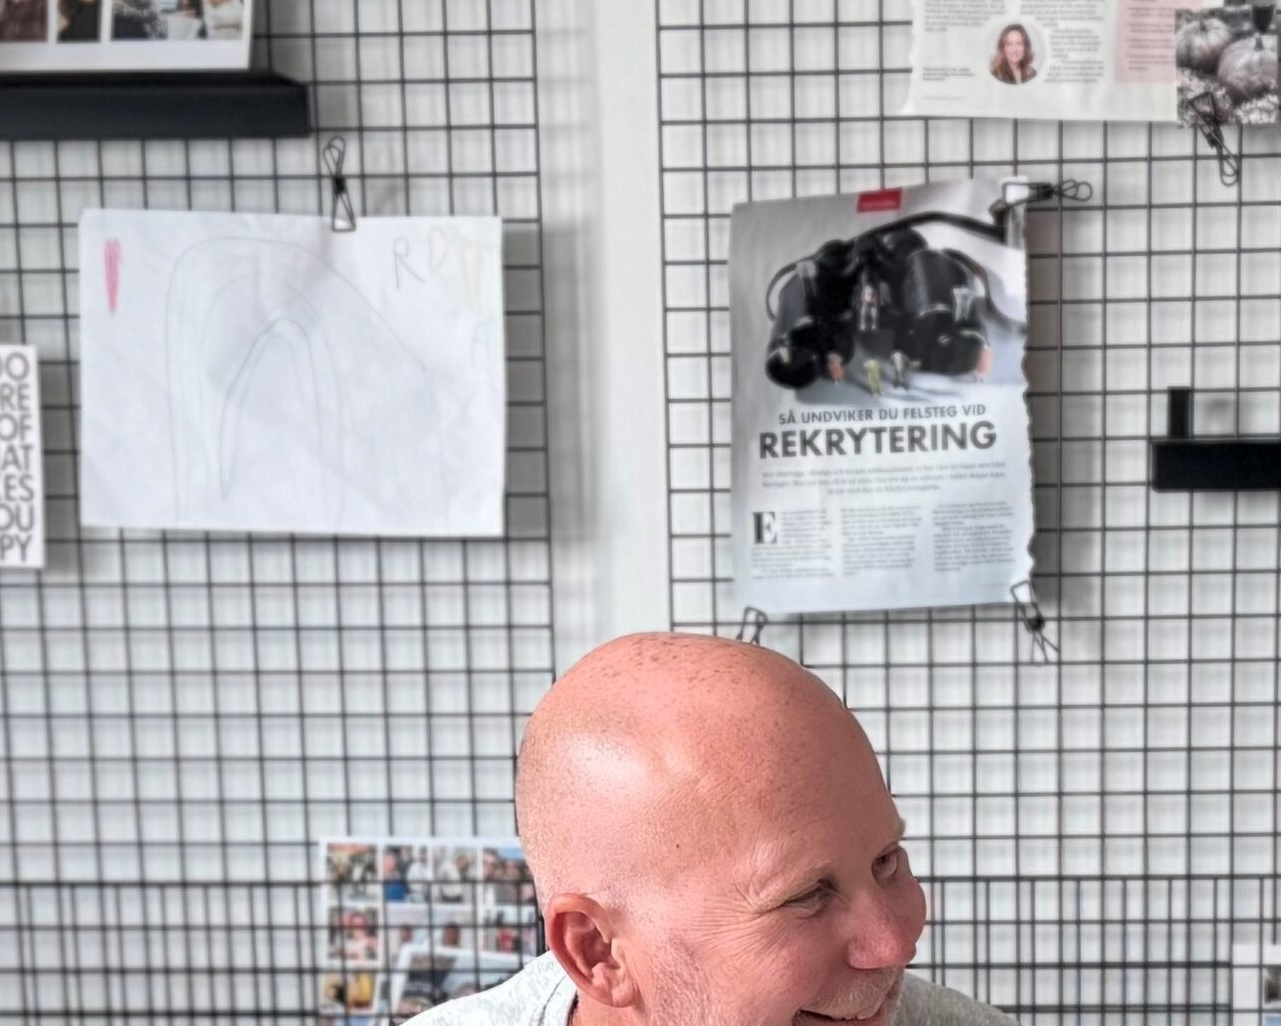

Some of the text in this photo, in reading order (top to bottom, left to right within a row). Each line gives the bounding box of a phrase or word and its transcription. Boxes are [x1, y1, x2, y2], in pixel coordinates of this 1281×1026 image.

[778, 404, 986, 425] SÅ UNDVIKER DU FELSTEG VID
[758, 420, 998, 460] REKRYTERING
